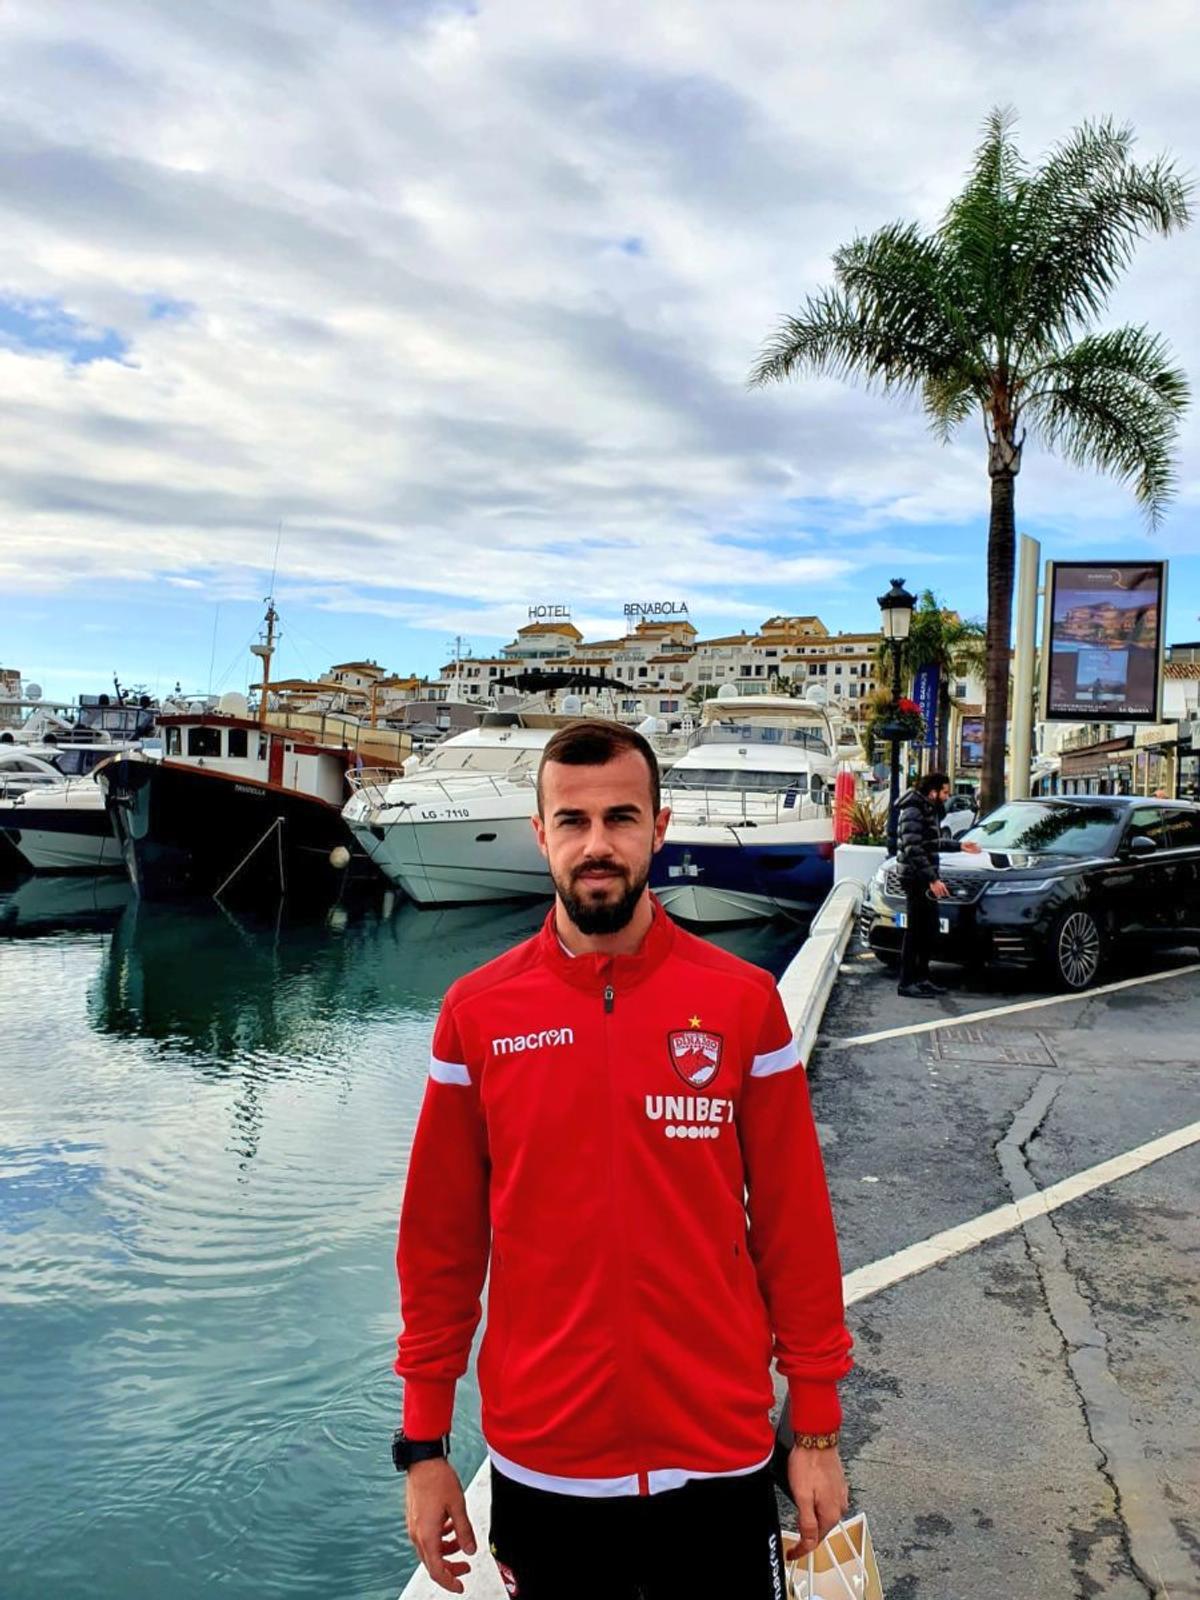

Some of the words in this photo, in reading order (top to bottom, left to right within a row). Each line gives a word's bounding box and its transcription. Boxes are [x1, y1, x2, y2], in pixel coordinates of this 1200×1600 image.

[528, 605, 571, 617] HOTEL
[623, 601, 689, 616] BENABOLA
[492, 1027, 574, 1056] macron
